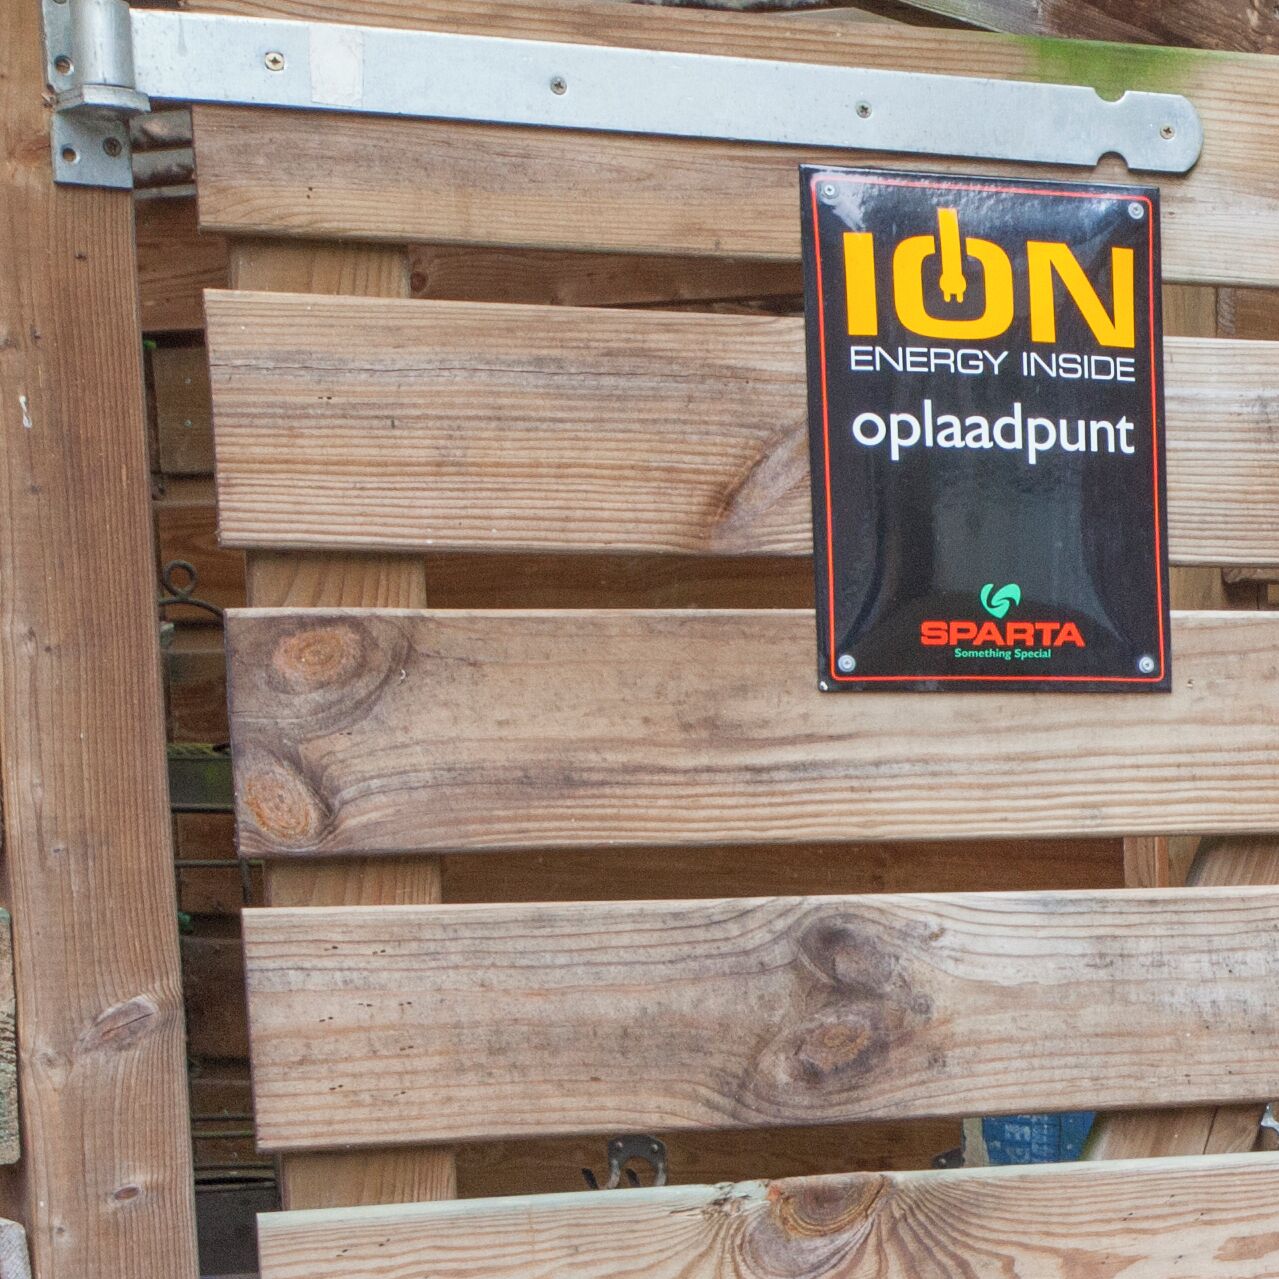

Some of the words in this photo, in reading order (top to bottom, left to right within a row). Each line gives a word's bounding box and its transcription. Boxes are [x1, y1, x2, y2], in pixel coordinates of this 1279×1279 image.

[843, 207, 1135, 348] ION
[850, 346, 1008, 375] ENERGY
[1022, 351, 1136, 382] INSIDE
[852, 399, 1135, 465] oplaadpunt
[920, 620, 1086, 647] SPARTA
[954, 648, 1012, 661] Something
[1014, 648, 1051, 661] Special
